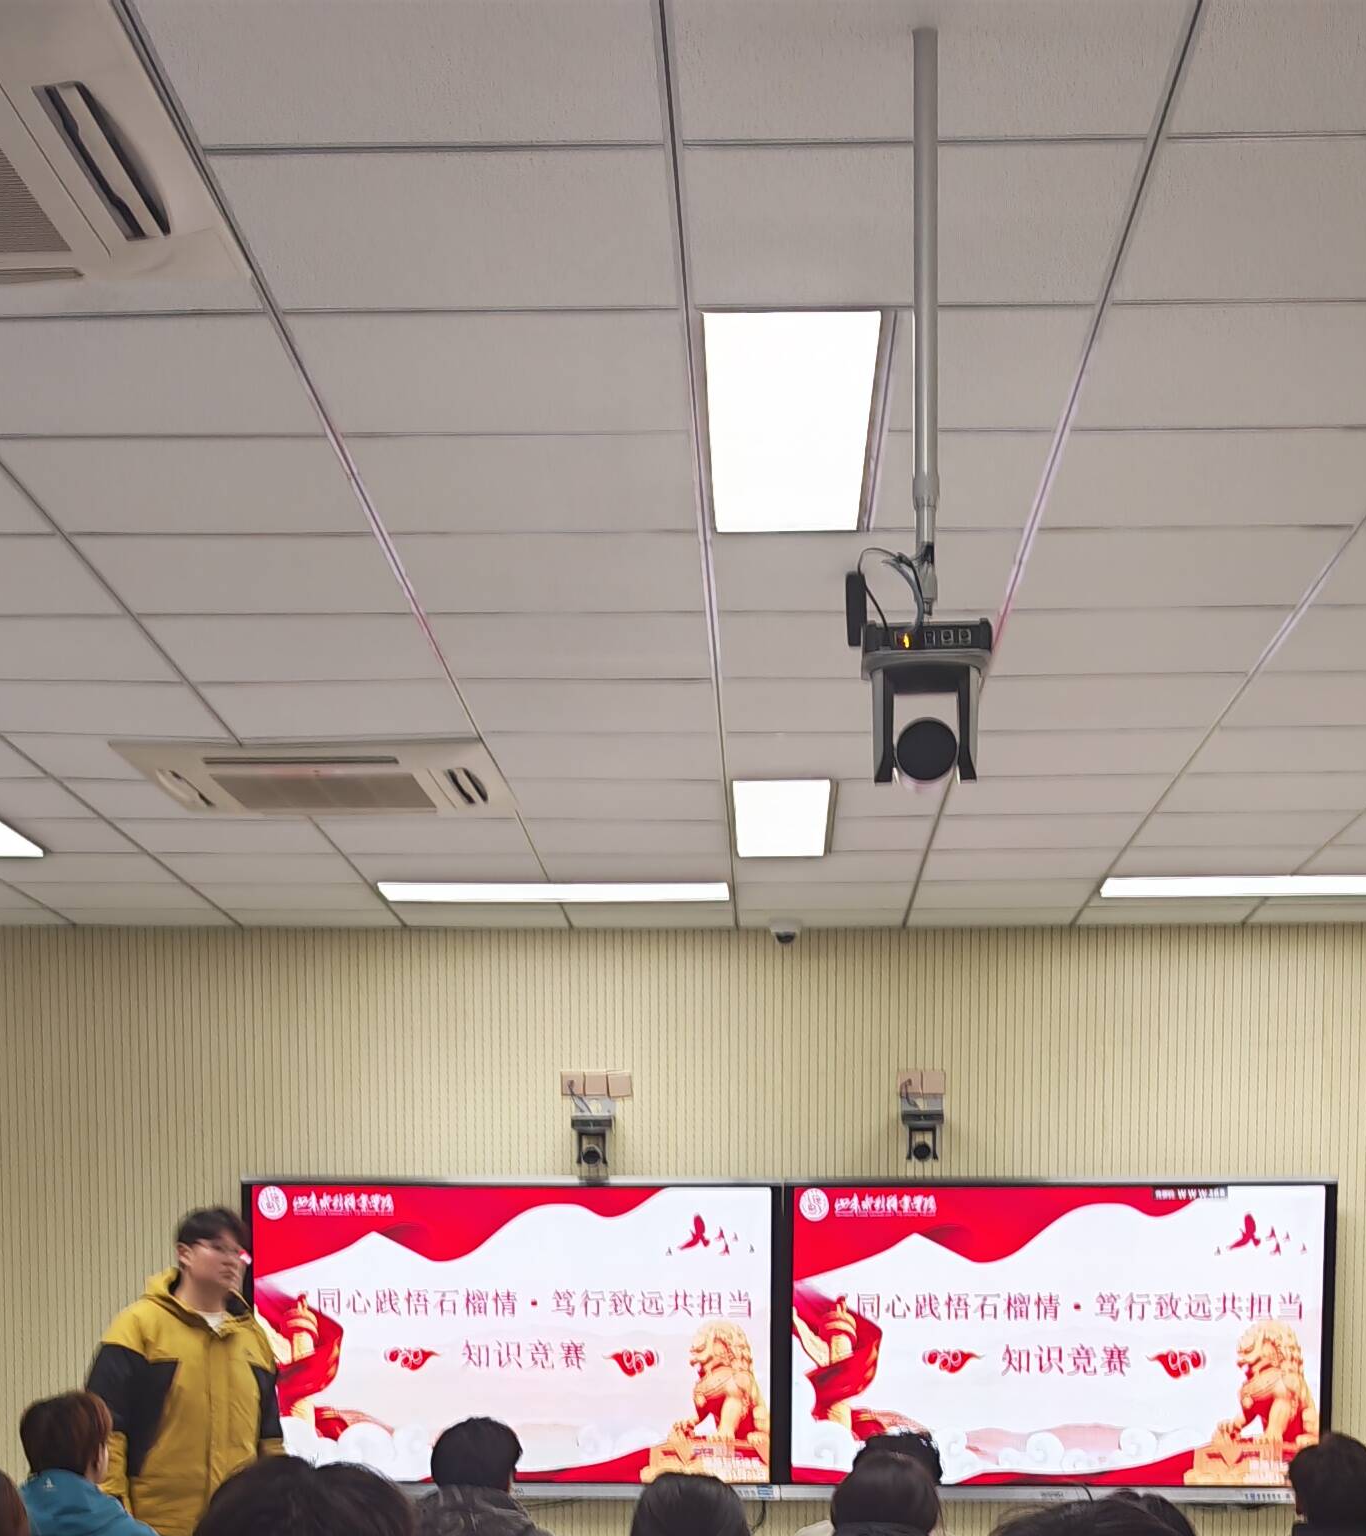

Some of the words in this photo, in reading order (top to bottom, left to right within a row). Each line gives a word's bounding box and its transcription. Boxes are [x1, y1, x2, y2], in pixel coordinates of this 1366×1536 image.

[461, 1339, 587, 1371] 知识竞赛
[1001, 1343, 1132, 1377] 知识竞赛
